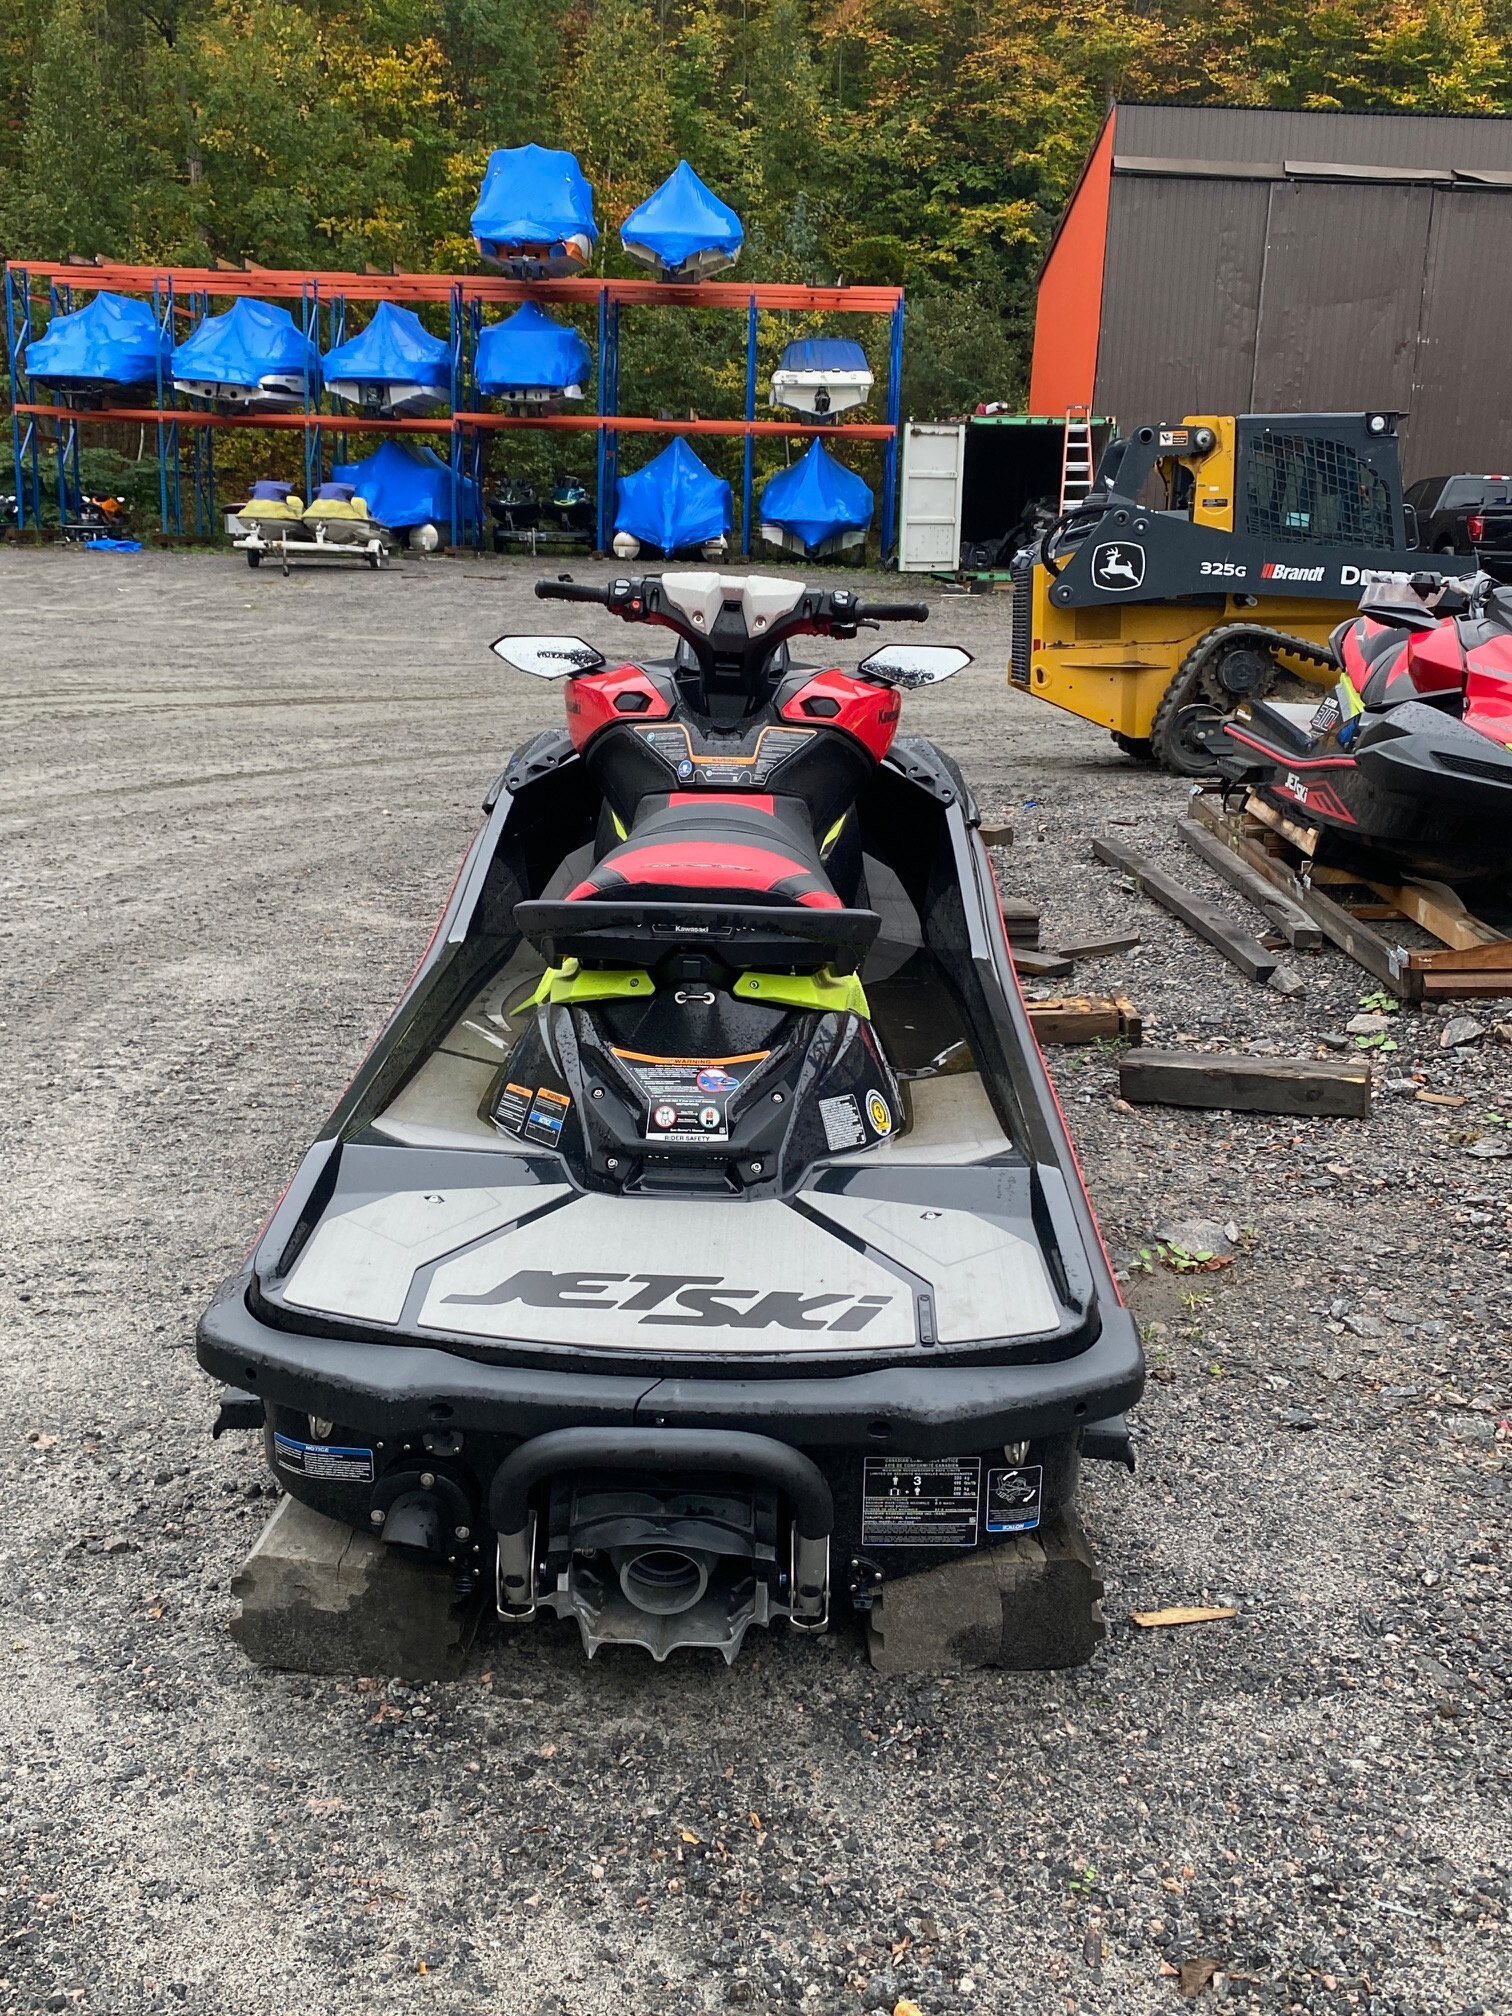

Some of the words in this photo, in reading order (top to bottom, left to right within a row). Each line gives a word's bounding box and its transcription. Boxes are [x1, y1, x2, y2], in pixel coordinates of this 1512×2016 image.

[1200, 561, 1247, 578] 325G
[1272, 564, 1325, 583] Brandt
[675, 925, 709, 933] Kawasaki
[305, 1445, 329, 1453] NOTICE
[913, 1476, 922, 1486] 3
